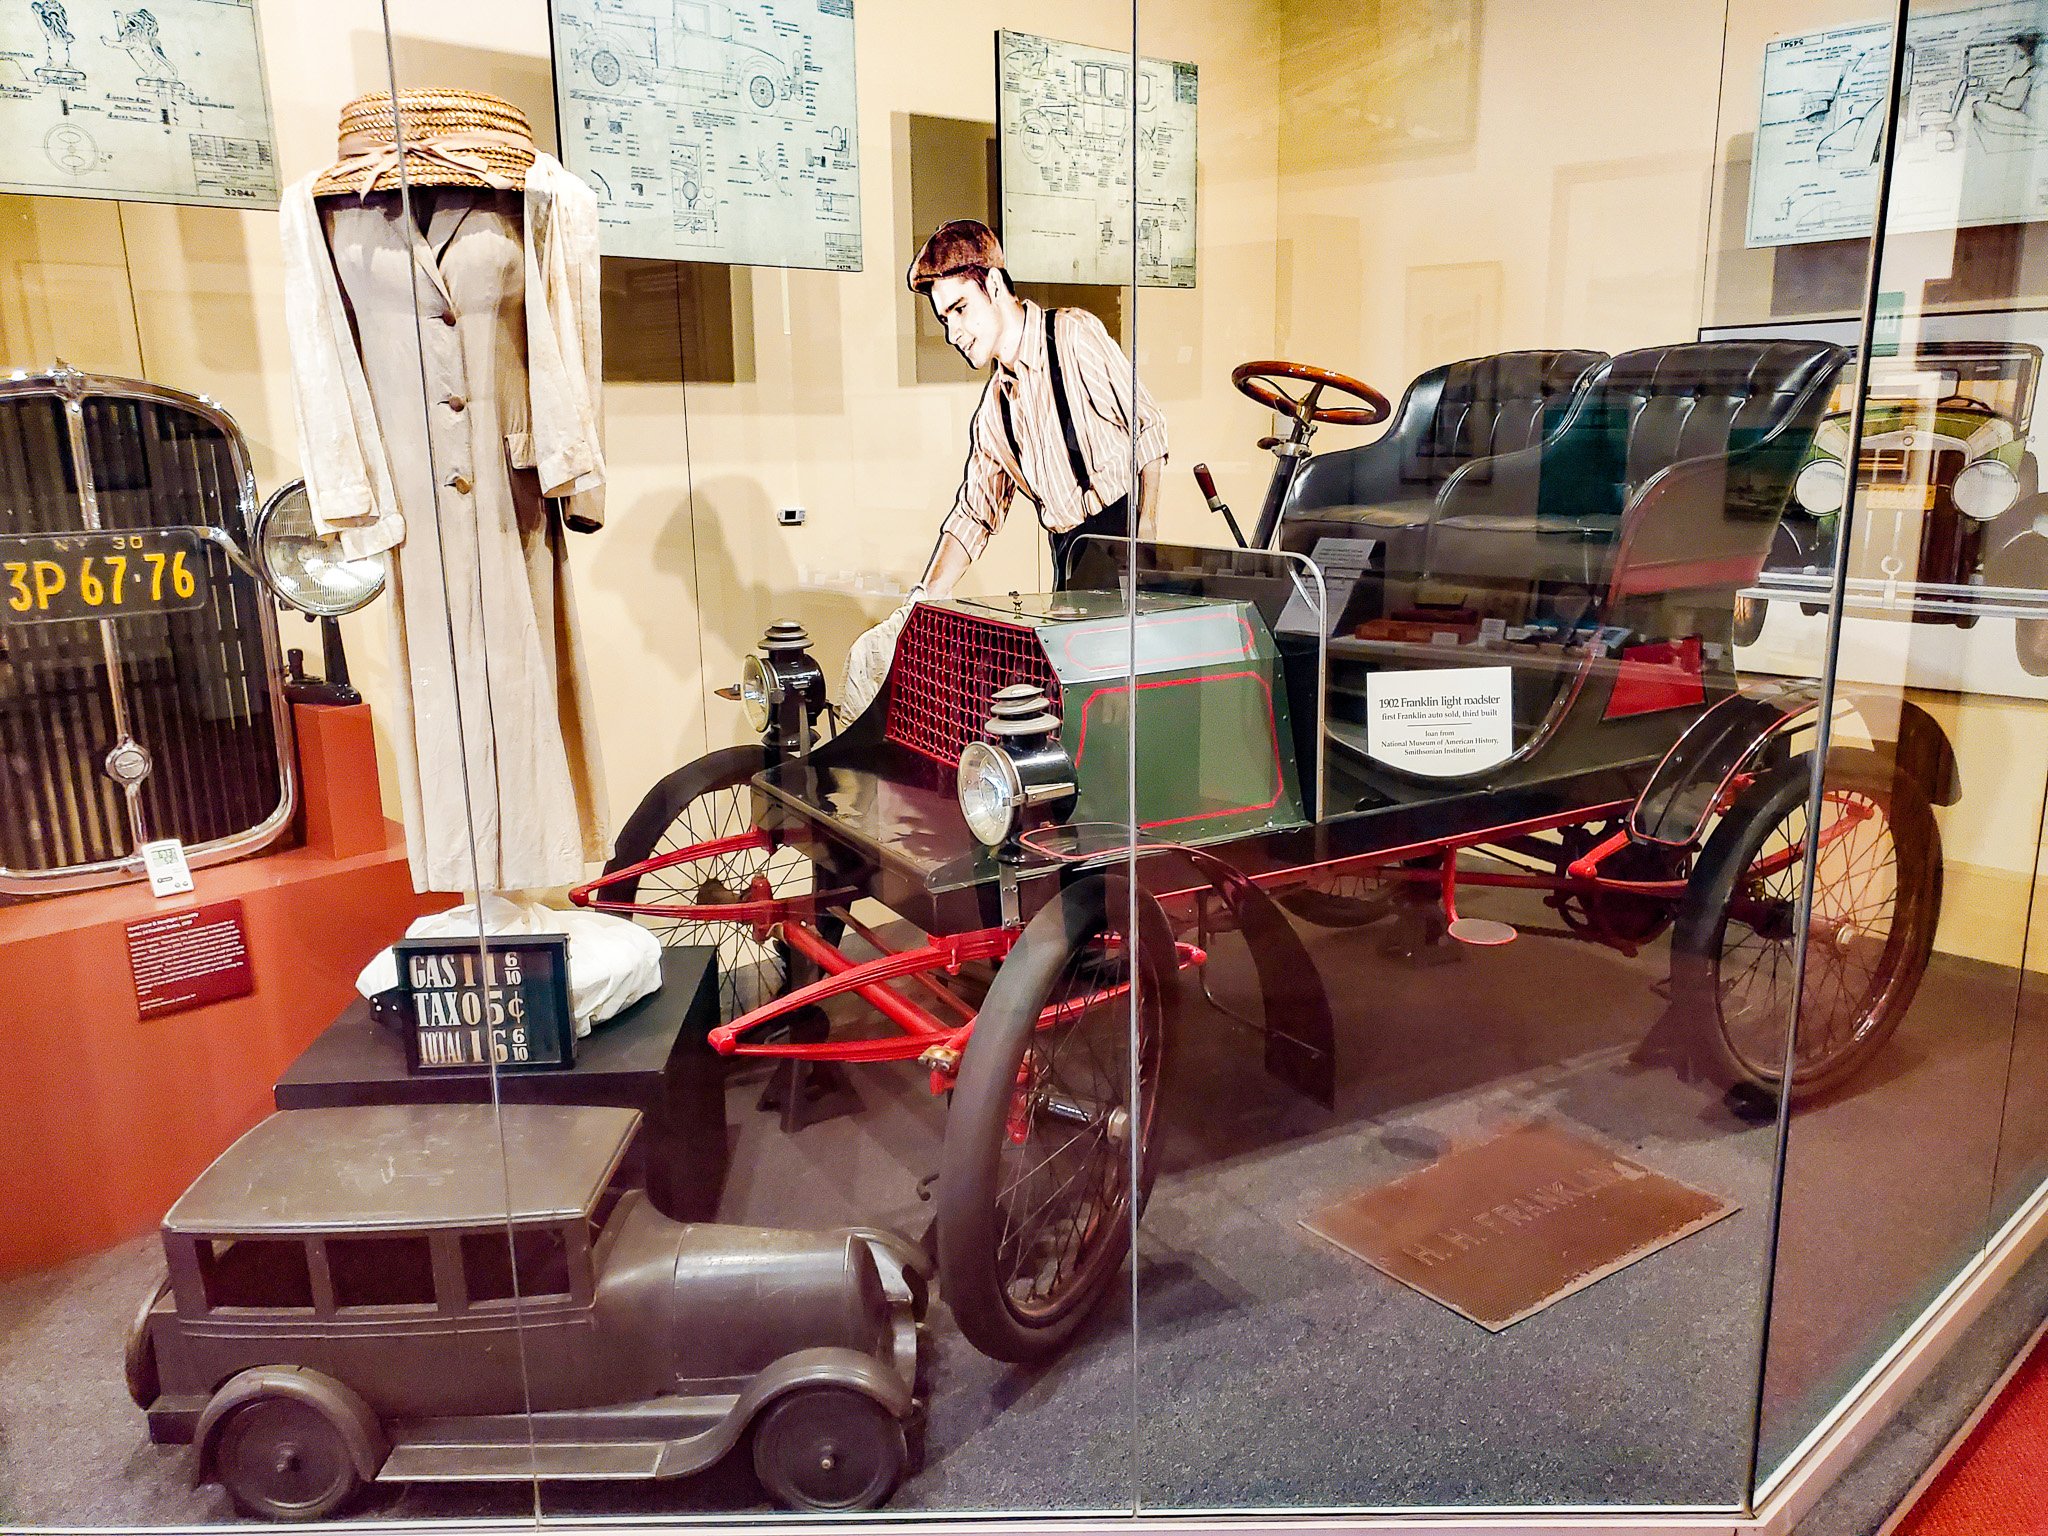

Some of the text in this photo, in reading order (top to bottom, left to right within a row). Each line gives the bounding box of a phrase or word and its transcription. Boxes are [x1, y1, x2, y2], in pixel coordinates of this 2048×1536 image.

[112, 536, 143, 550] 30
[3, 561, 66, 612] 3P
[1379, 694, 1500, 709] 1902 Franklin light roadster
[1382, 713, 1396, 721] first
[1397, 711, 1427, 720] Franklin
[1444, 710, 1461, 719] sold,
[1462, 709, 1480, 718] third
[1480, 708, 1498, 717] built
[1381, 740, 1408, 748] National
[1408, 739, 1436, 747] Museum
[1444, 738, 1474, 746] American
[1404, 747, 1476, 756] Smithsonian Institution
[409, 953, 457, 989] GAS
[412, 992, 462, 1027] TAX
[420, 1031, 466, 1065] TOTAL
